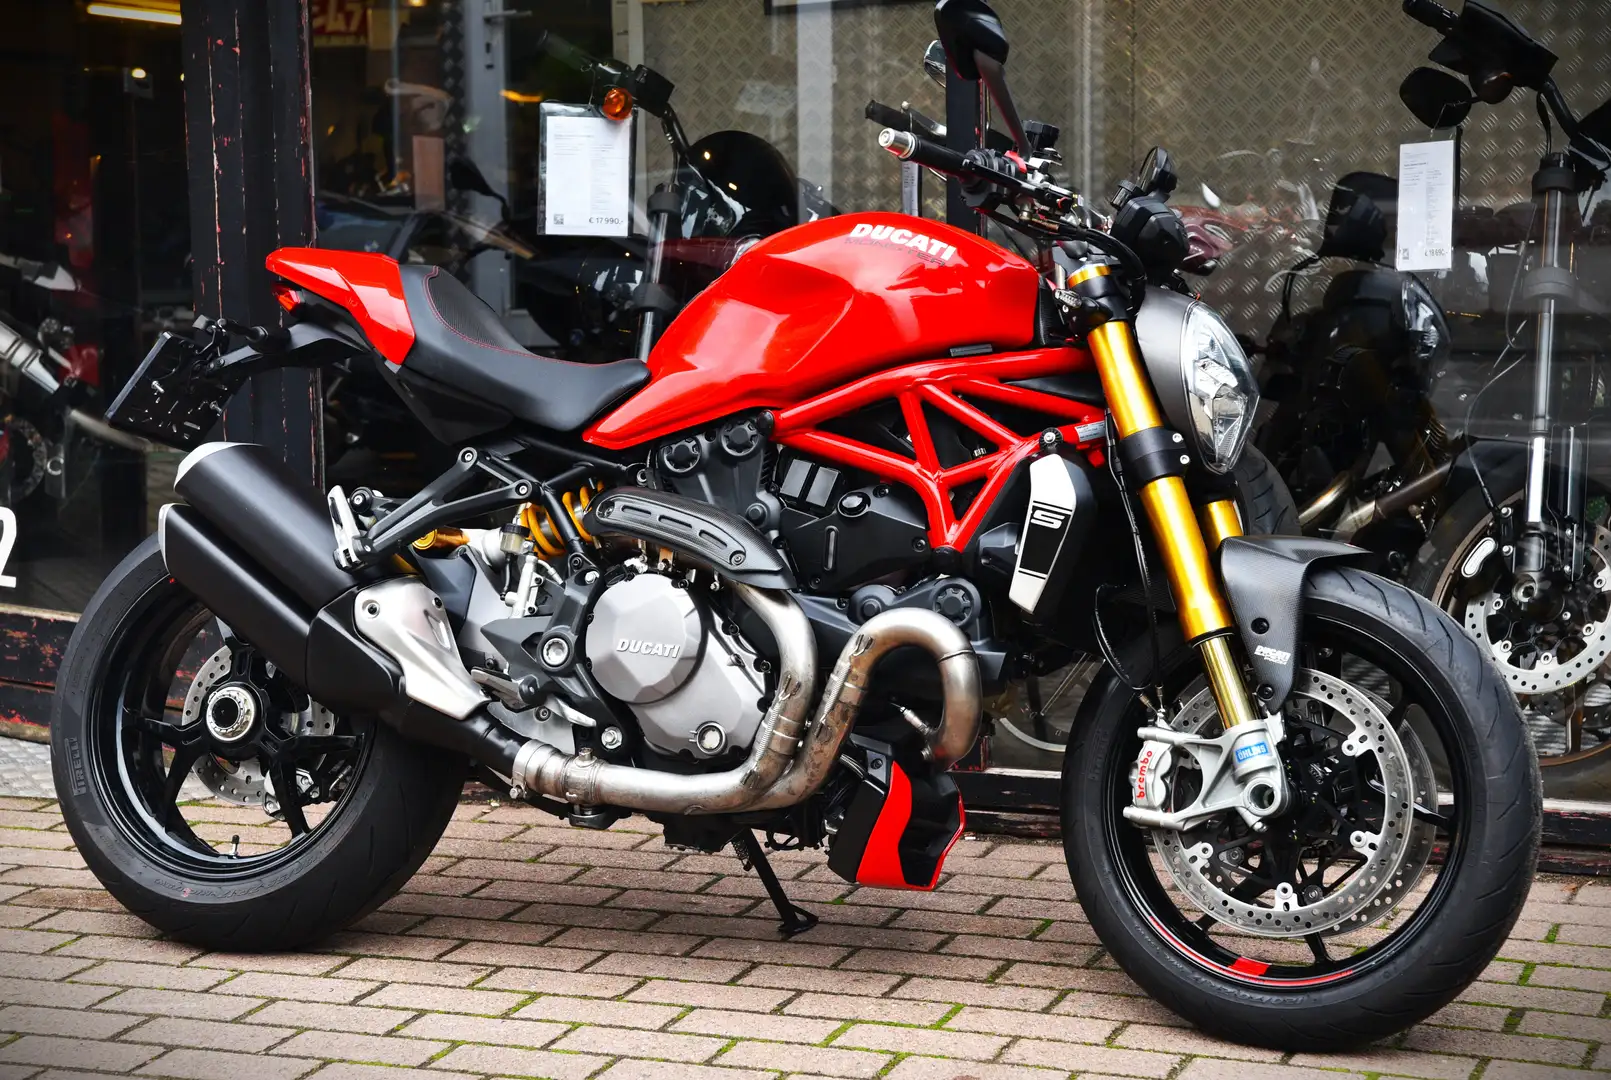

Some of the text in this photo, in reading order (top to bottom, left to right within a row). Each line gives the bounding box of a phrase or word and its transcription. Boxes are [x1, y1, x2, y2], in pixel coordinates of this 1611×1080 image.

[850, 223, 957, 261] DUCATI
[616, 639, 681, 658] DUCATI
[1136, 750, 1153, 799] brembo
